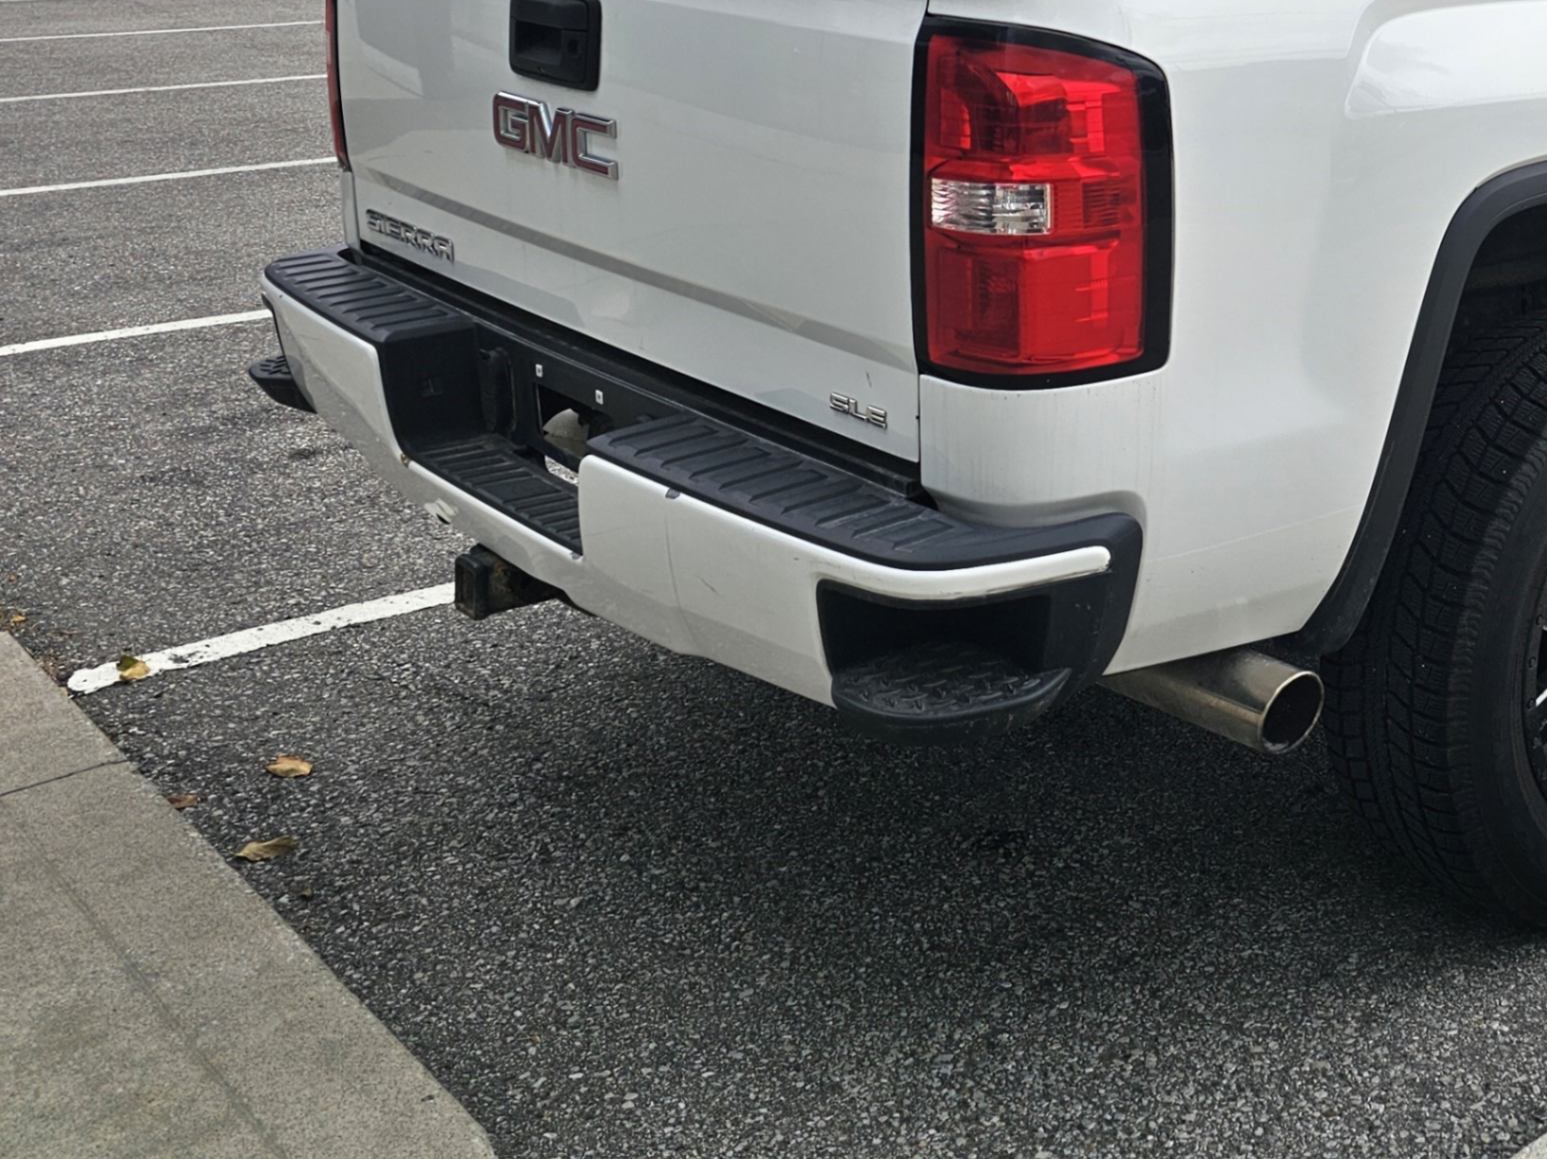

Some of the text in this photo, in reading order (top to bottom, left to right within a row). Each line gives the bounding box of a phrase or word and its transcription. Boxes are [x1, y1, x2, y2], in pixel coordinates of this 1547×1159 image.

[492, 90, 619, 181] GMC
[365, 208, 455, 264] SIERRA
[829, 391, 888, 430] SLE
